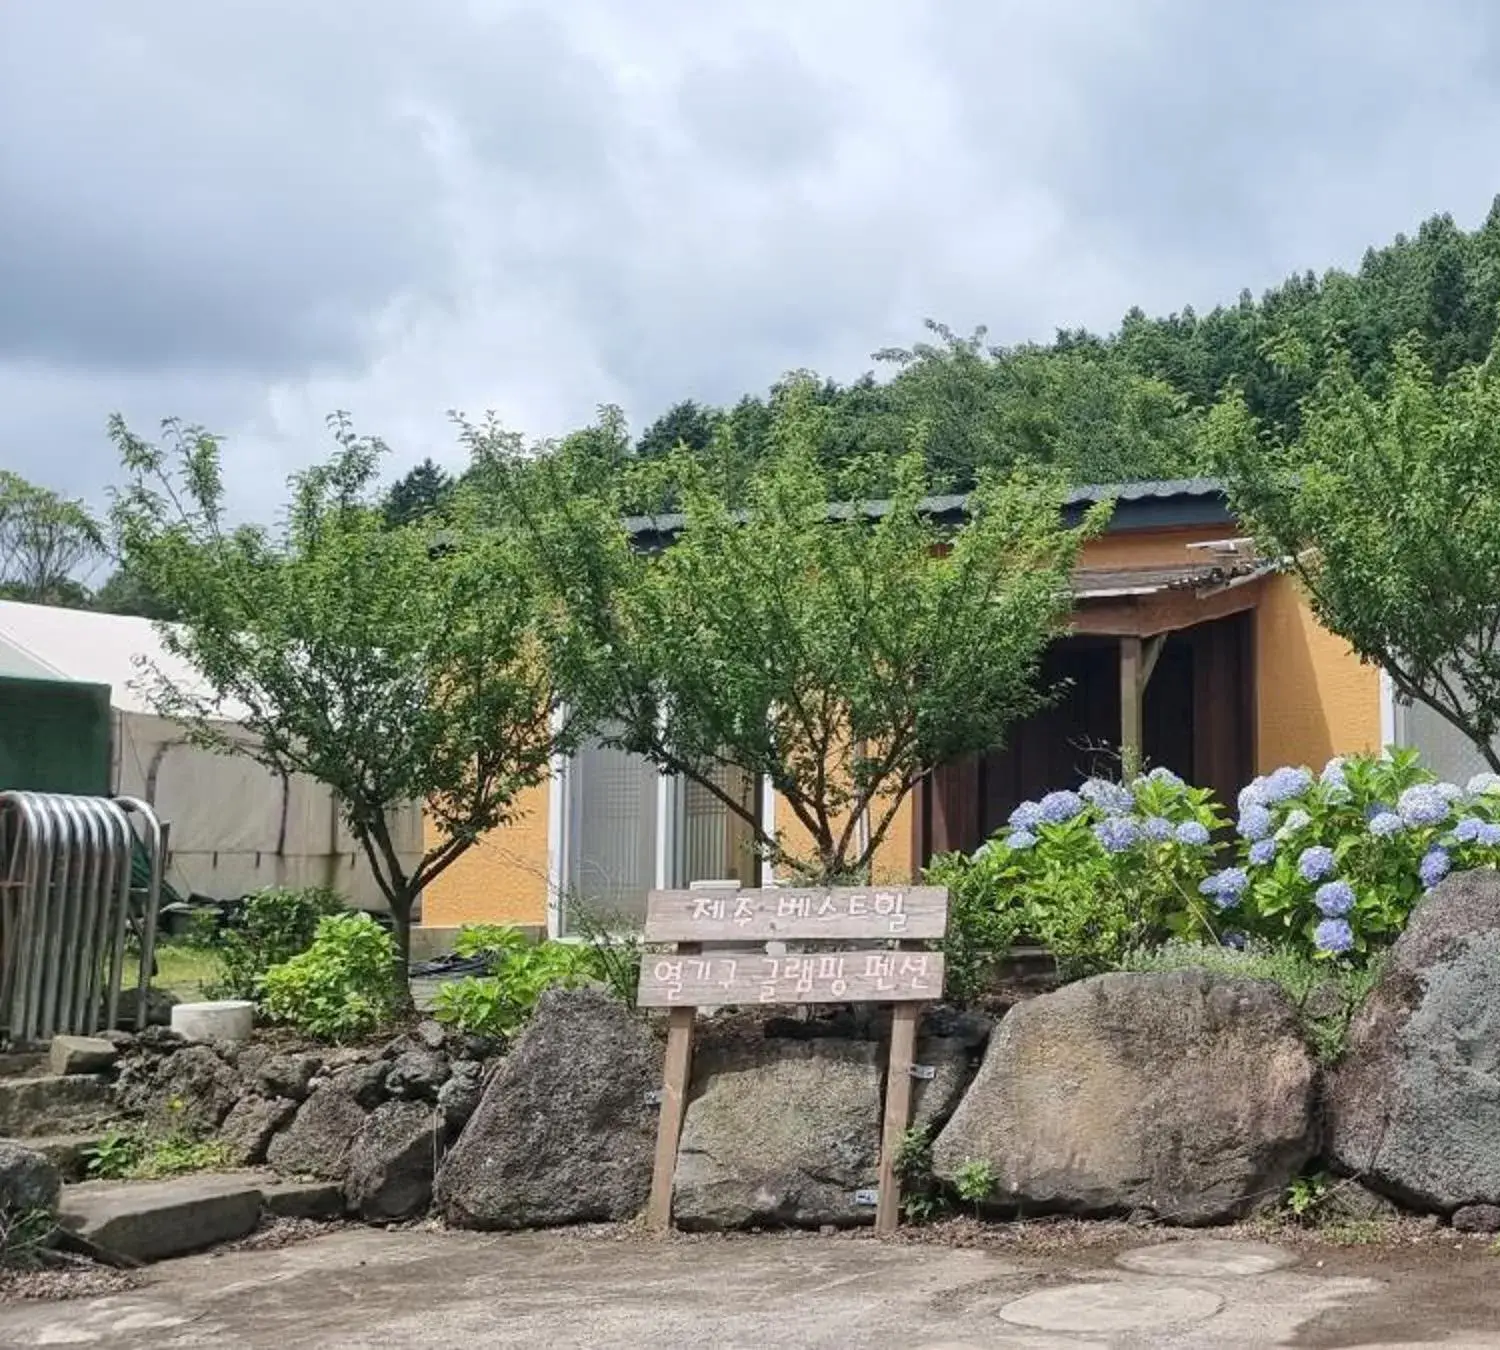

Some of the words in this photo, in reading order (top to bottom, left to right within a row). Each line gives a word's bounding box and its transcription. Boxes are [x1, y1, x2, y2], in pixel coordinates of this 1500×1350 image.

[691, 896, 754, 927] 제주
[776, 892, 908, 933] 베스트힐
[654, 959, 738, 1001] 열기구
[759, 957, 848, 1003] 글램핑
[864, 955, 930, 991] 펜션
